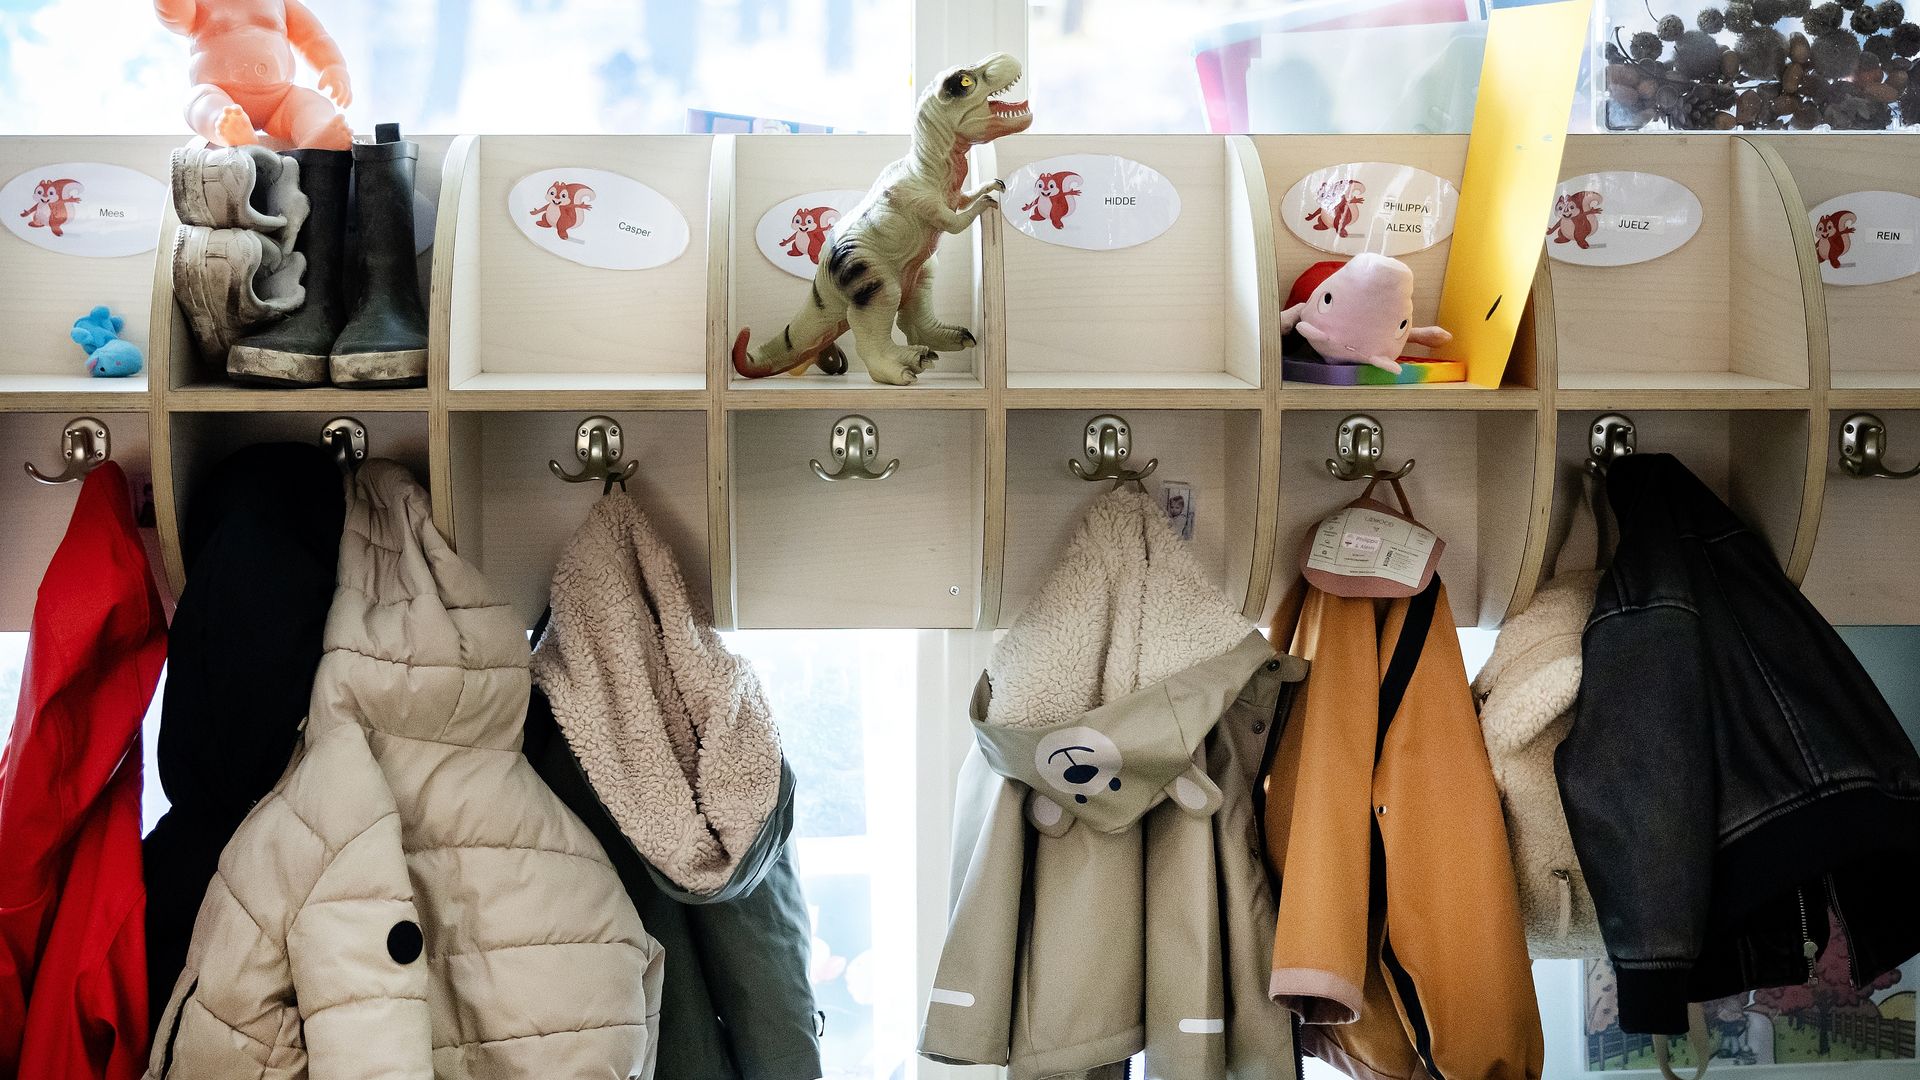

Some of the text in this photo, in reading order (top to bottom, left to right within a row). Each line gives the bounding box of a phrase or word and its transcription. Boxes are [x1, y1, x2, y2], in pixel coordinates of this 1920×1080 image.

[1104, 196, 1136, 206] HIDDE
[1383, 201, 1429, 214] PHILIPPA
[99, 208, 125, 218] Mees
[618, 221, 652, 237] Casper
[1385, 223, 1422, 233] ALEXIS
[1617, 219, 1650, 230] JUELZ
[1876, 231, 1901, 241] REIN
